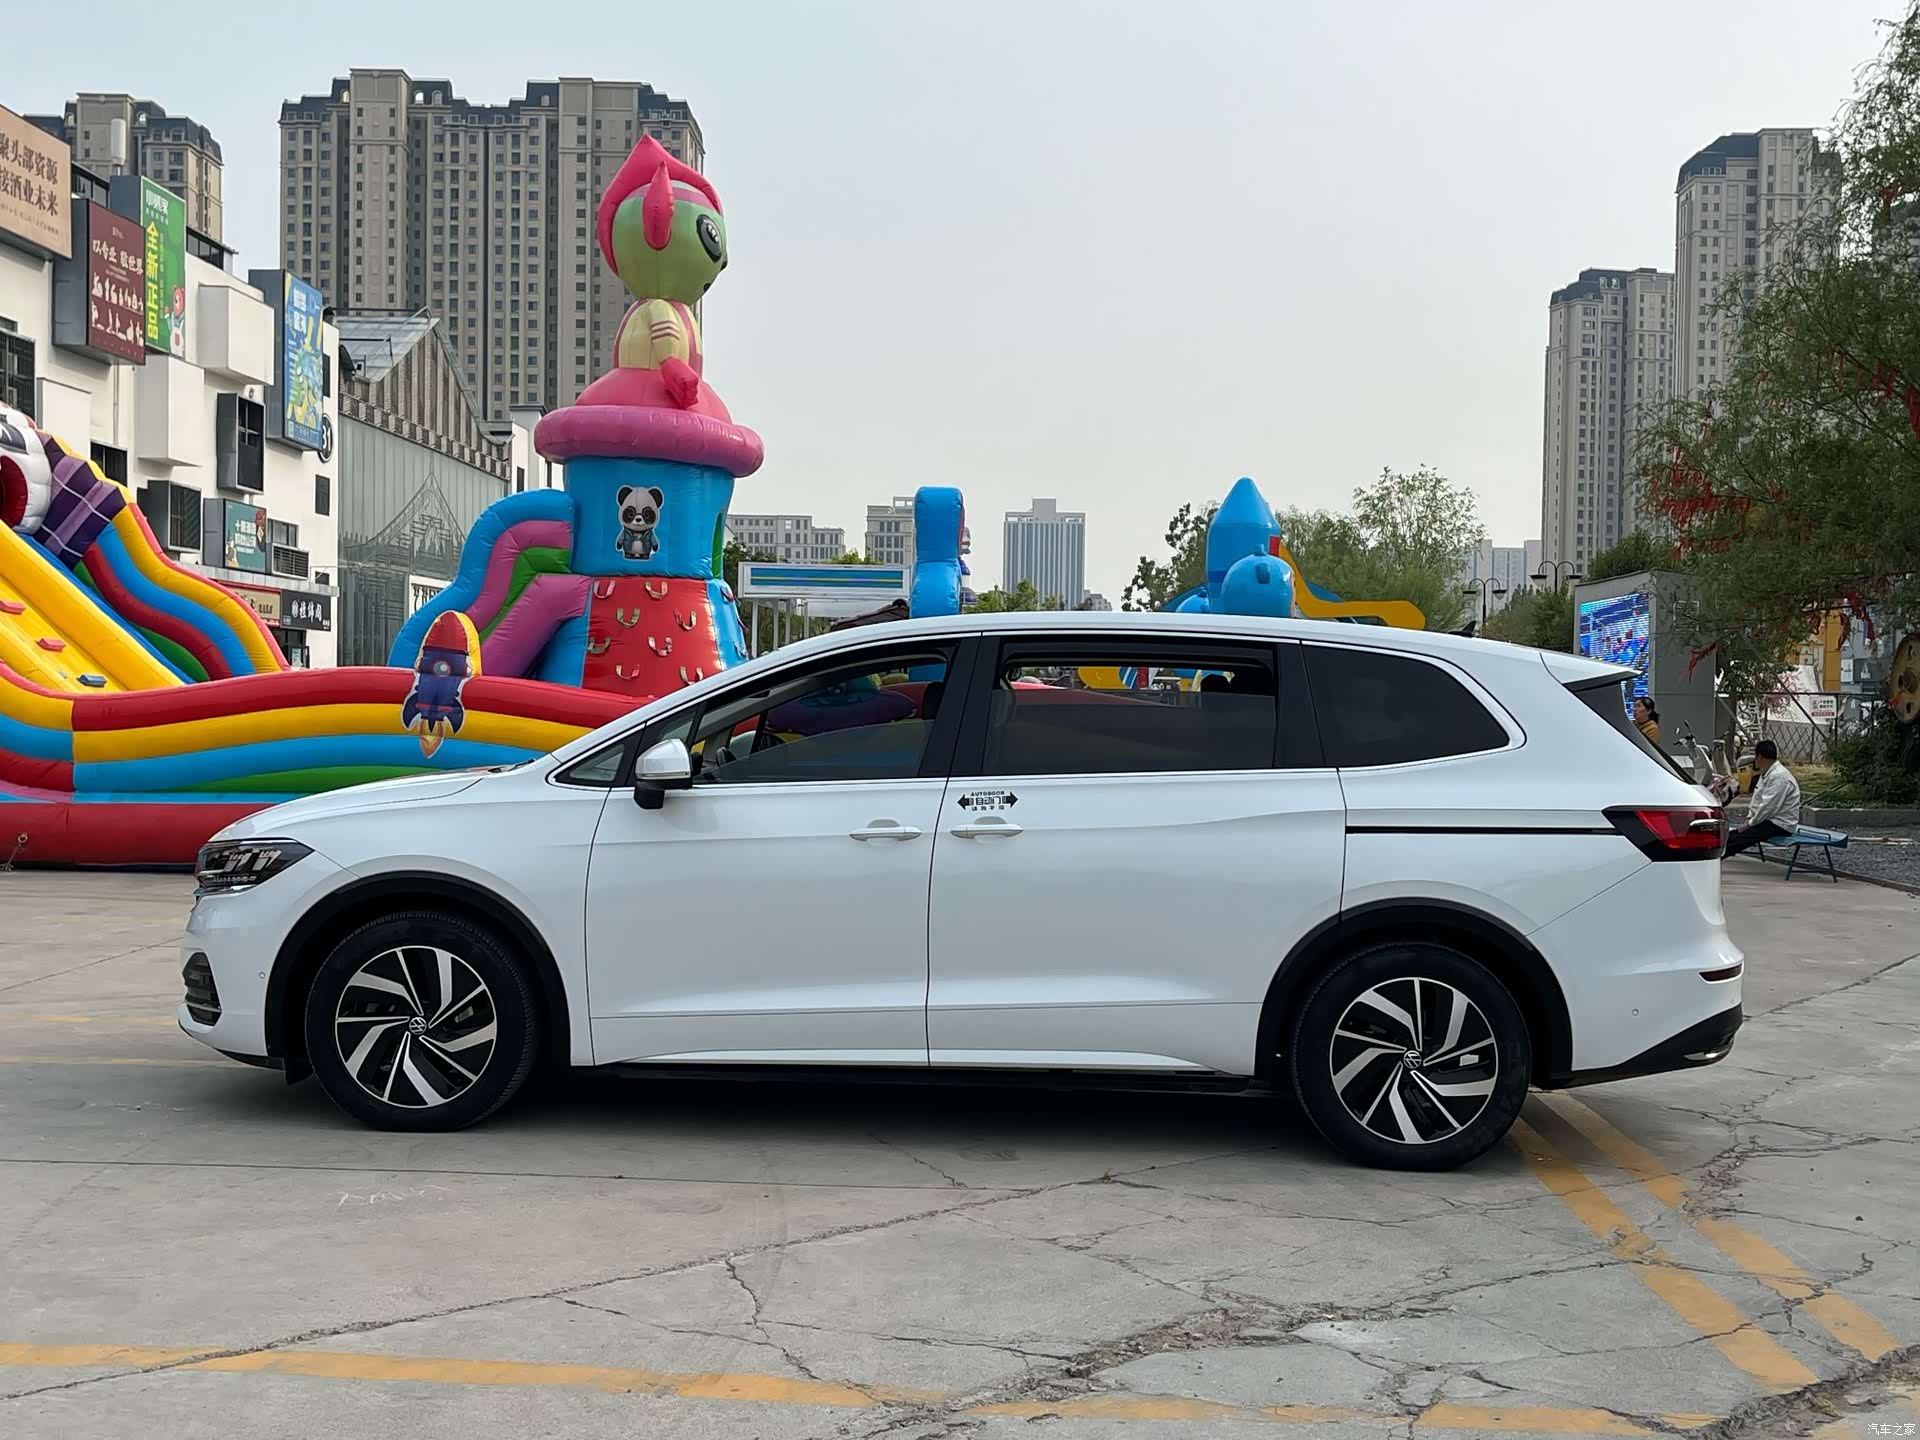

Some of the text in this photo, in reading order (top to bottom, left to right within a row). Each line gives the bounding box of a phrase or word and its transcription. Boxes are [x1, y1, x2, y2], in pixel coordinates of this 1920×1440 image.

[146, 221, 159, 342] 全新正品
[975, 796, 1001, 805] 自动门
